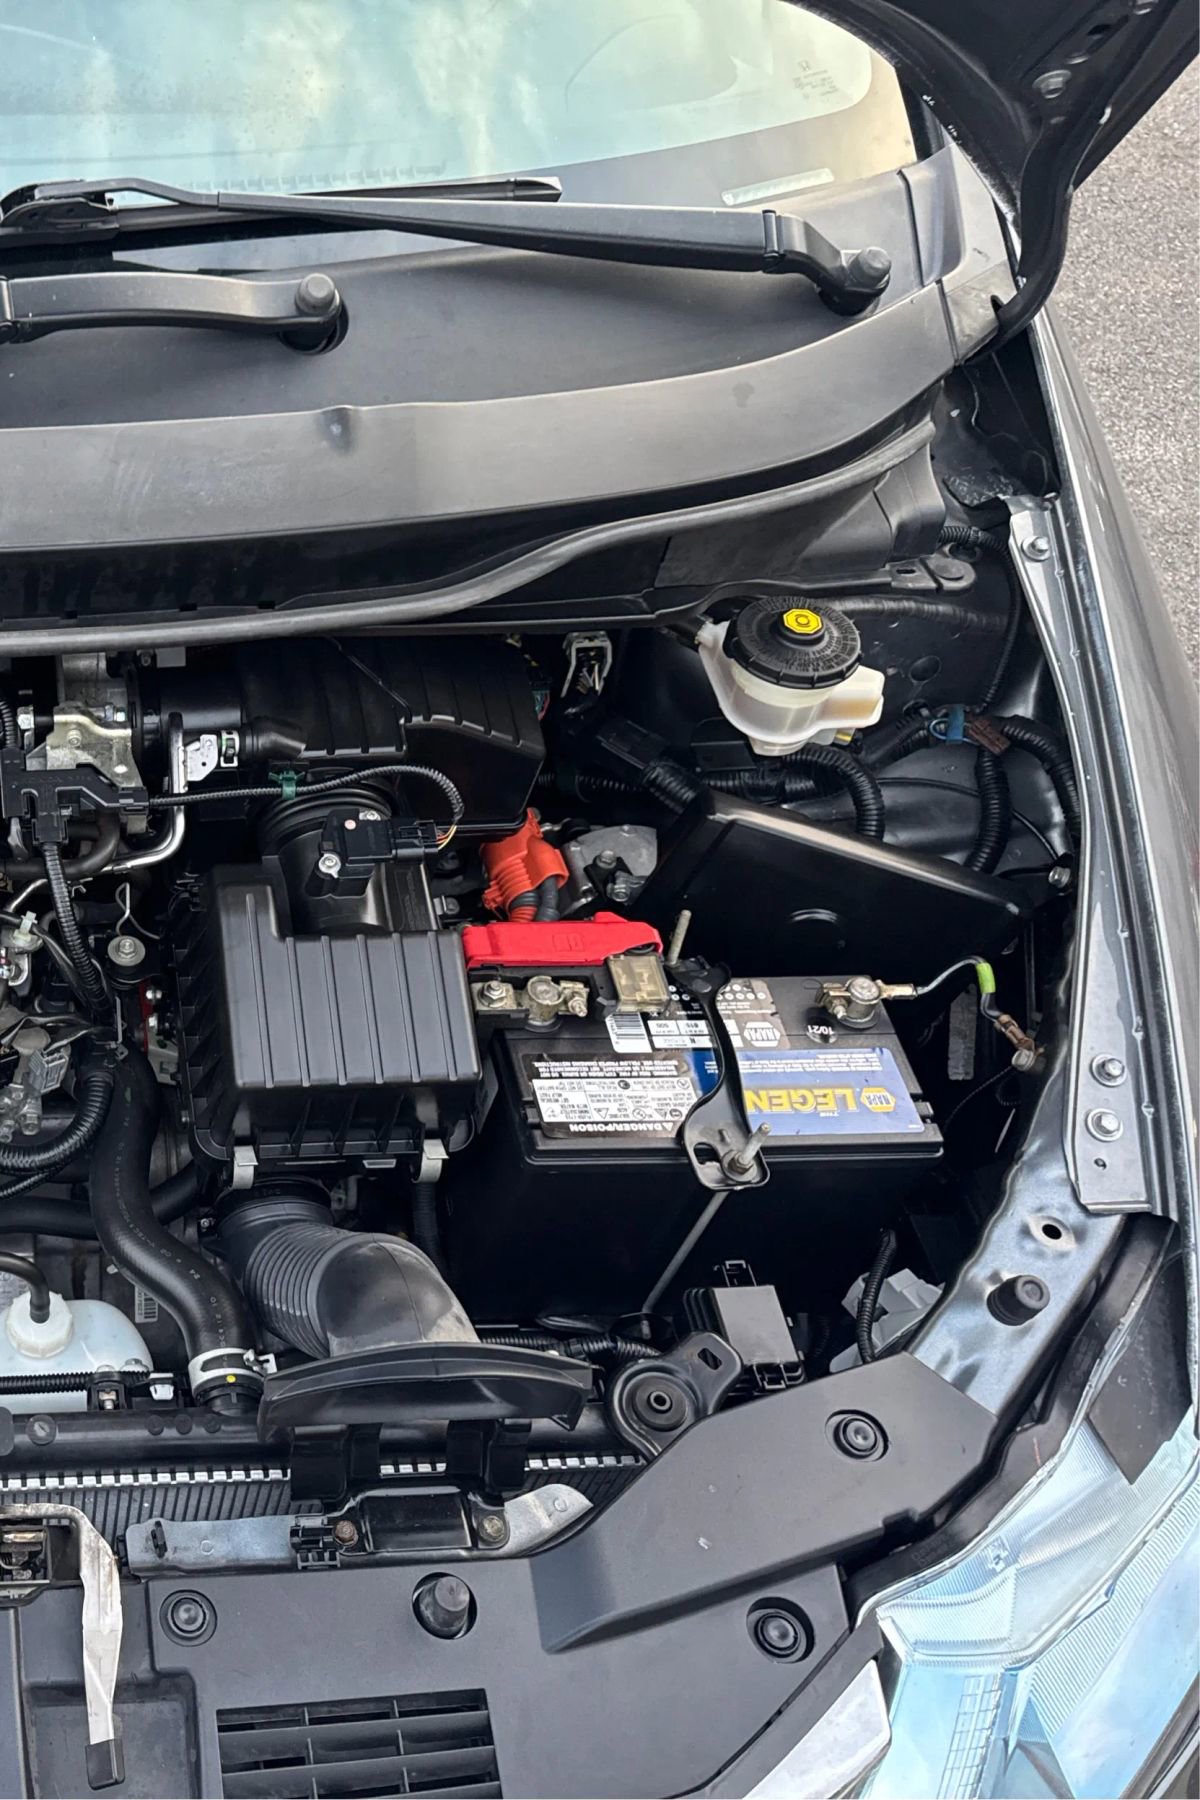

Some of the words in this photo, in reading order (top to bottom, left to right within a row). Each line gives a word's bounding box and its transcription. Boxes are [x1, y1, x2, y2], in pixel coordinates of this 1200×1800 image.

[747, 1028, 775, 1041] NAPA
[807, 1025, 835, 1035] 10/21
[745, 1087, 858, 1113] LEGEN
[863, 1093, 891, 1108] NAPA
[569, 1122, 662, 1131] DANGER/POISON
